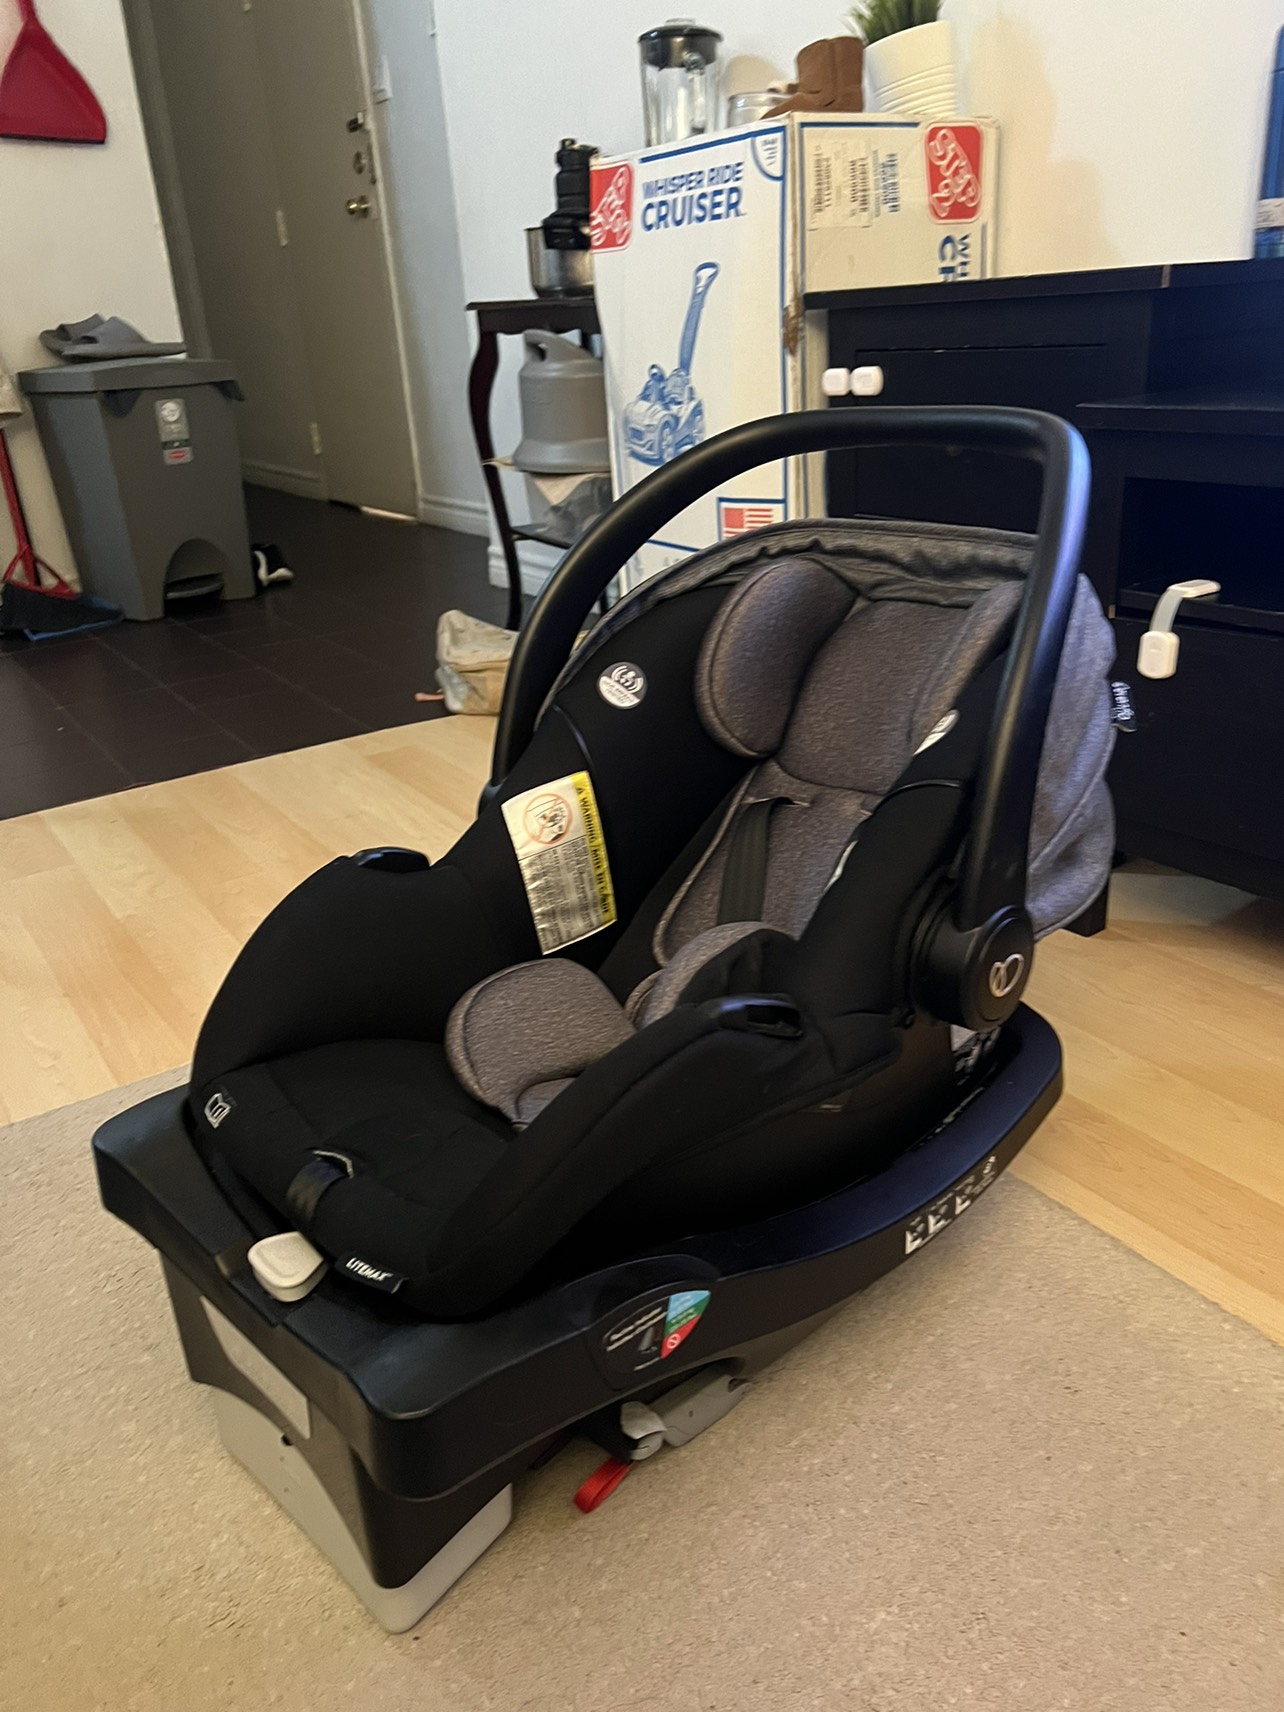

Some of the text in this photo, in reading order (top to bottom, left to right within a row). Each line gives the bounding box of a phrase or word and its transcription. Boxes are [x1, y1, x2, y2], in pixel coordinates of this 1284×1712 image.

[642, 161, 745, 199] WHISPER RIDE
[641, 186, 743, 232] CRUISER
